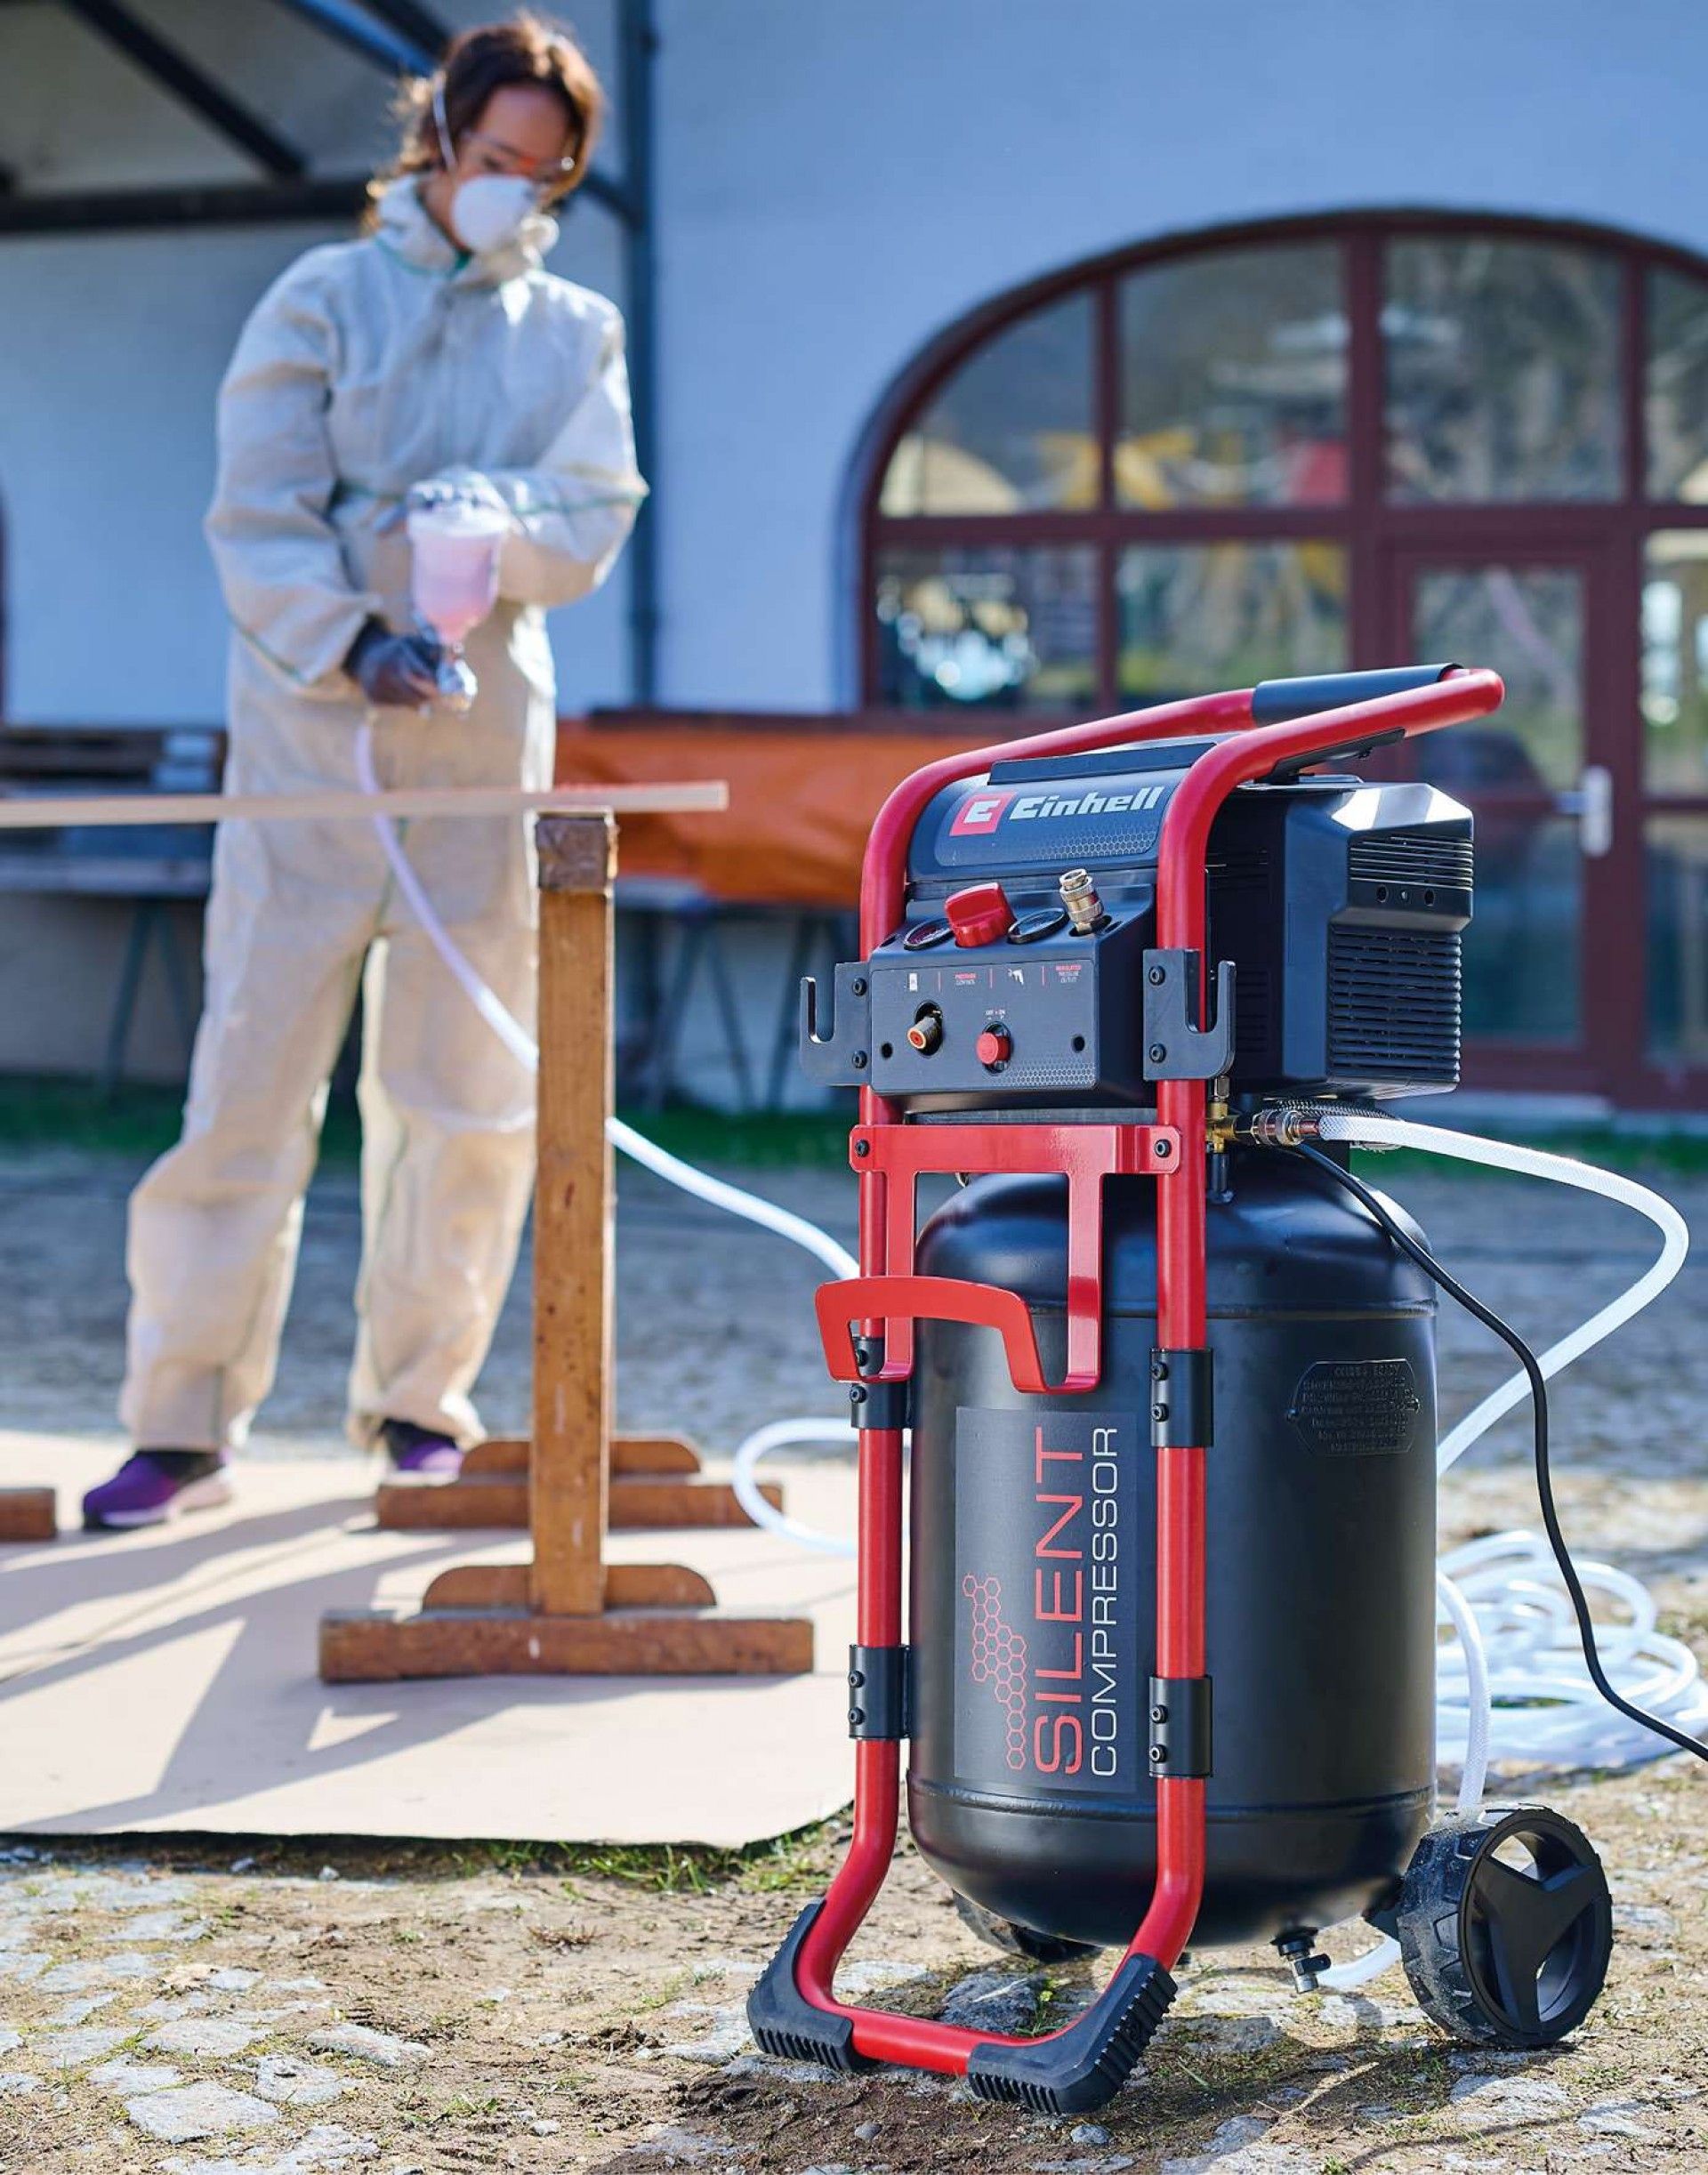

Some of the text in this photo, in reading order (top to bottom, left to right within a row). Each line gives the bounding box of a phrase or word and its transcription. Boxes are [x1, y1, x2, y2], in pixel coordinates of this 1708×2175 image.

[1009, 786, 1164, 820] Einhell
[1035, 1427, 1083, 1776] SILENT
[1092, 1428, 1118, 1777] COMPRESSOR
